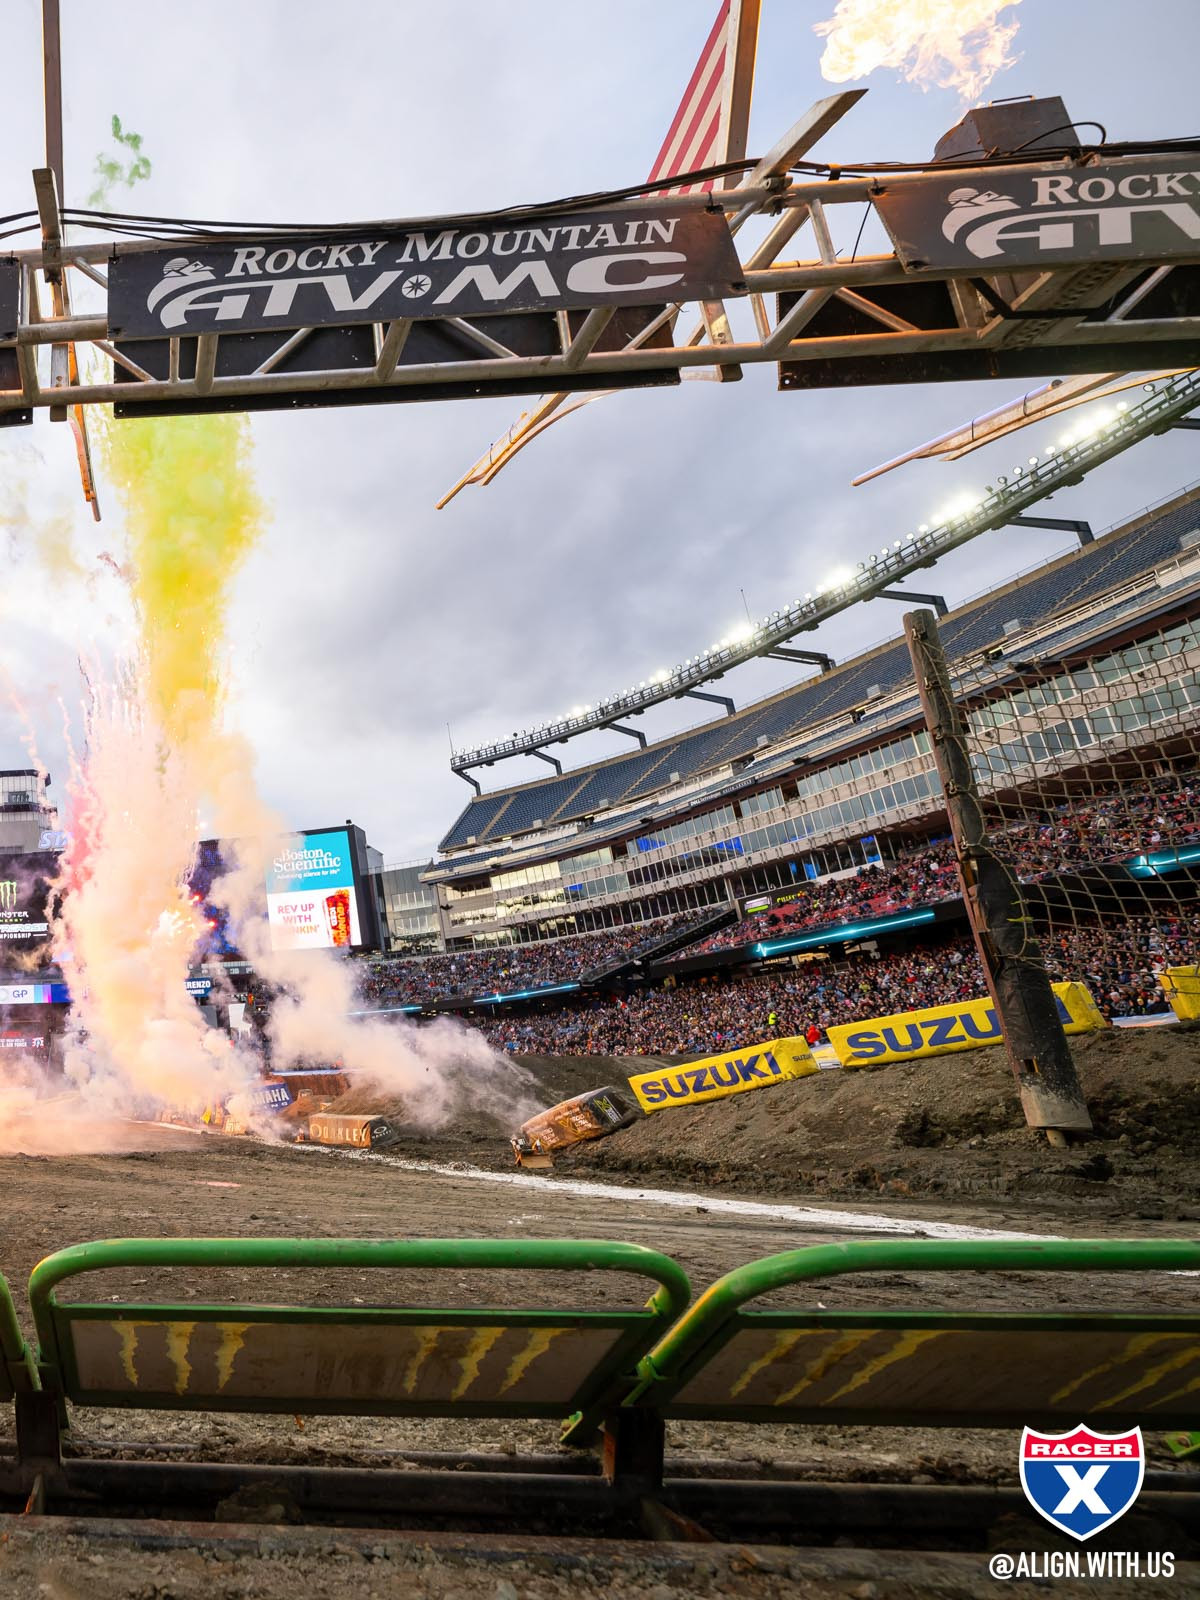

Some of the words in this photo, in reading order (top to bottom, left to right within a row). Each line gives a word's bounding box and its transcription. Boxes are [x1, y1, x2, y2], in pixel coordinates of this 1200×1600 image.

[1031, 171, 1200, 206] ROCK
[224, 241, 389, 278] ROCKY
[395, 218, 681, 263] MOUNTAIN
[273, 852, 342, 873] Scientific
[282, 848, 324, 861] Boston
[277, 905, 298, 914] REV
[300, 903, 315, 912] UP
[282, 914, 312, 924] WITH
[640, 1051, 782, 1103] SUZUKI
